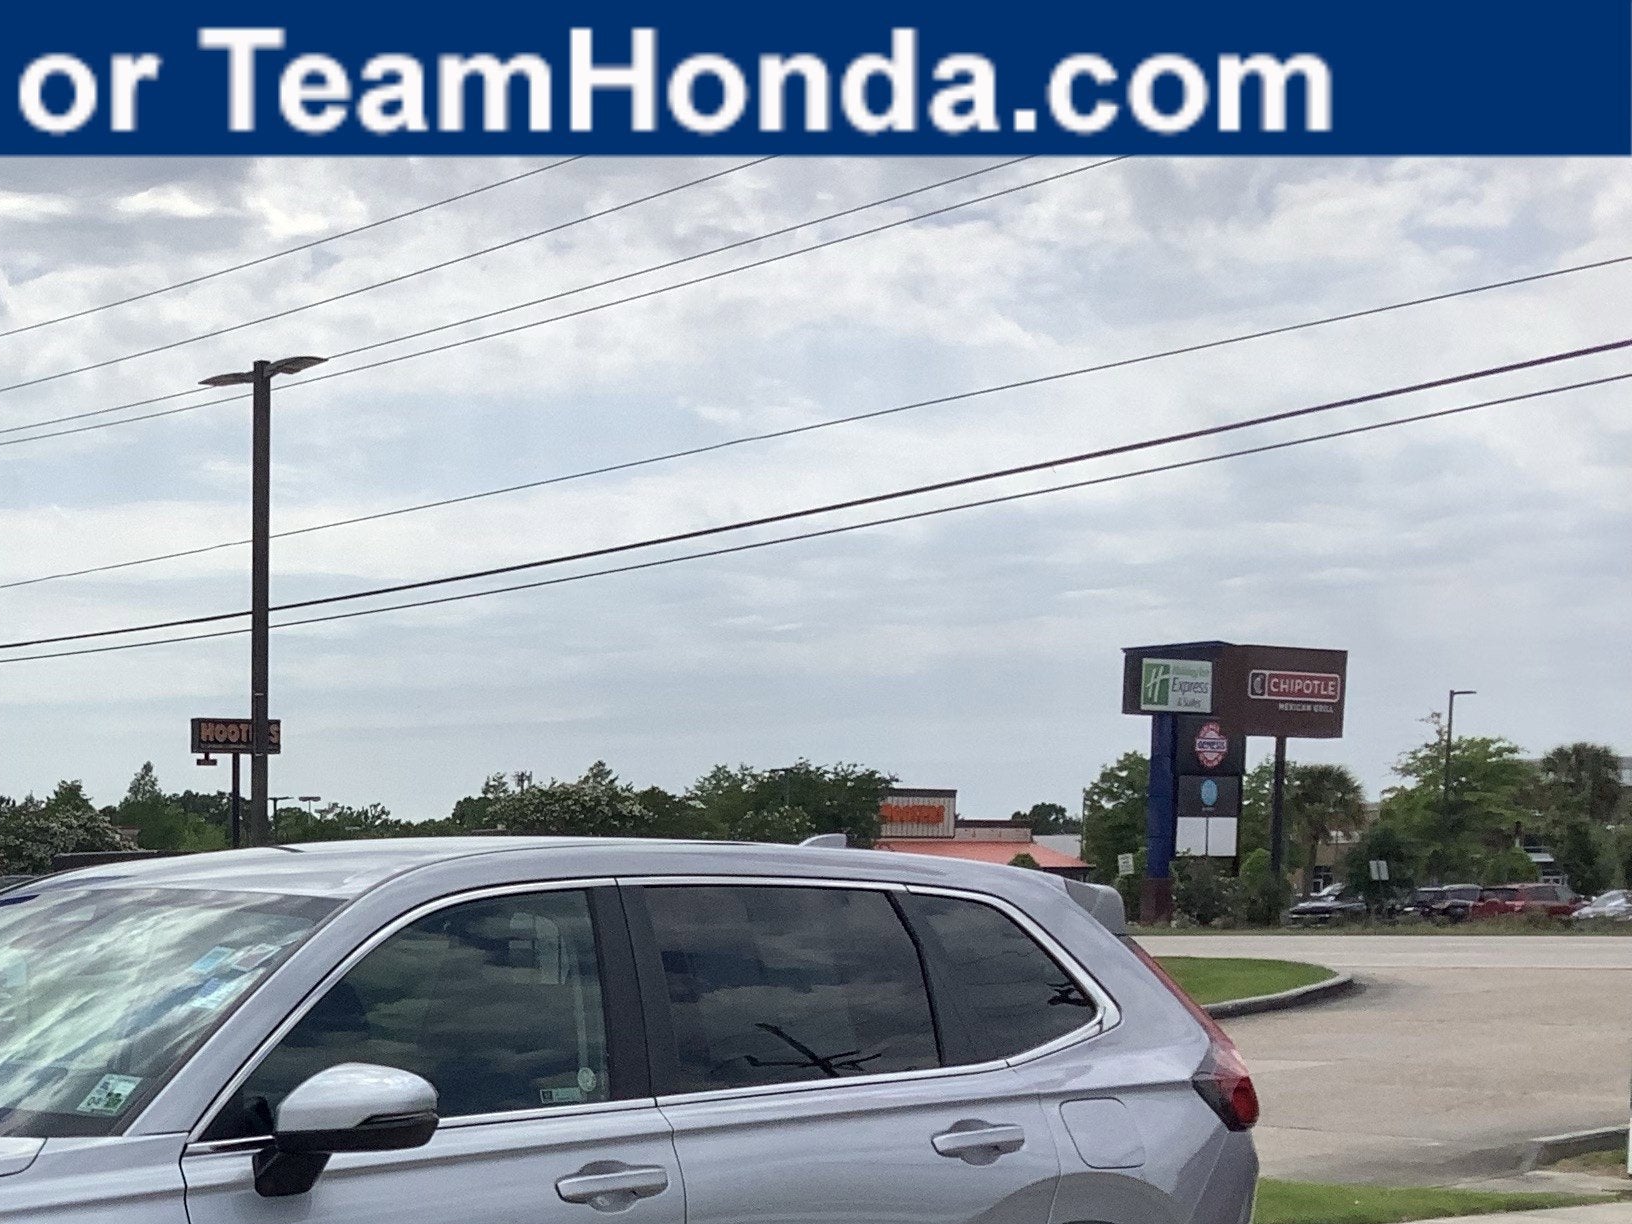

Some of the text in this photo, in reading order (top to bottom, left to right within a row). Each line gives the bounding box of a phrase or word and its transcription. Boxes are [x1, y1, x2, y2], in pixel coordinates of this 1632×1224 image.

[1172, 677, 1209, 695] Express
[1270, 678, 1336, 695] CHIPOTLE
[200, 722, 280, 743] HOOTS
